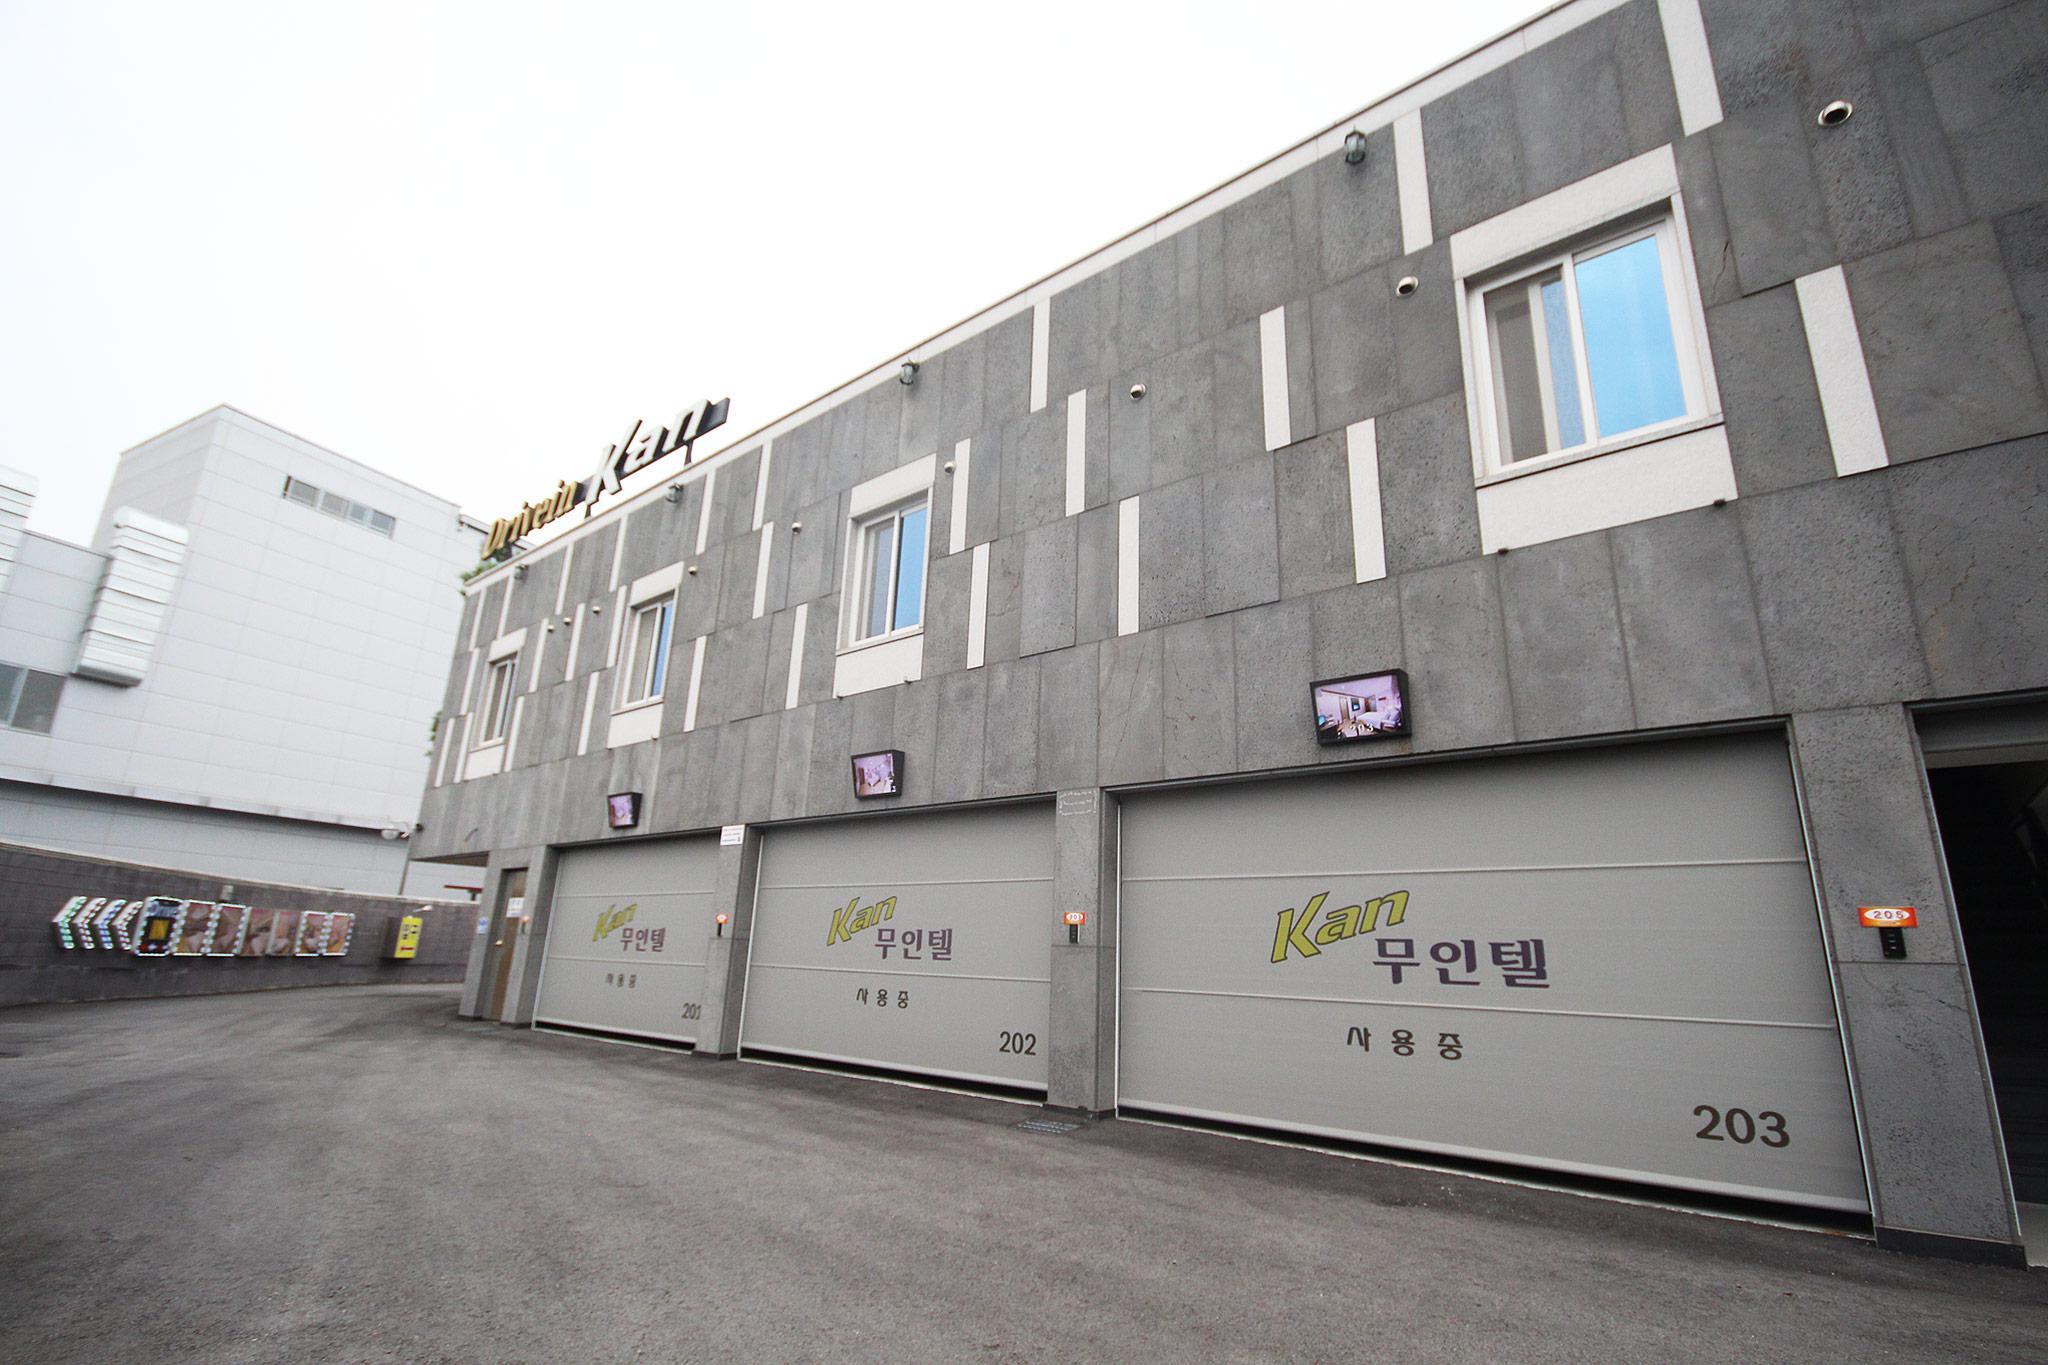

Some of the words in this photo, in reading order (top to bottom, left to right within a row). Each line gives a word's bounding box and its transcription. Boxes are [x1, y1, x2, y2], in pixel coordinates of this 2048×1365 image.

[585, 397, 713, 506] Kan
[592, 903, 638, 942] Kan
[620, 927, 666, 953] 무인텔
[826, 895, 898, 947] Kan
[1270, 889, 1410, 964] Kan
[874, 927, 954, 962] 무인텔
[1372, 937, 1550, 990] 무인텔
[681, 1002, 702, 1021] 201
[999, 1030, 1037, 1056] 202
[1693, 1104, 1791, 1149] 203
